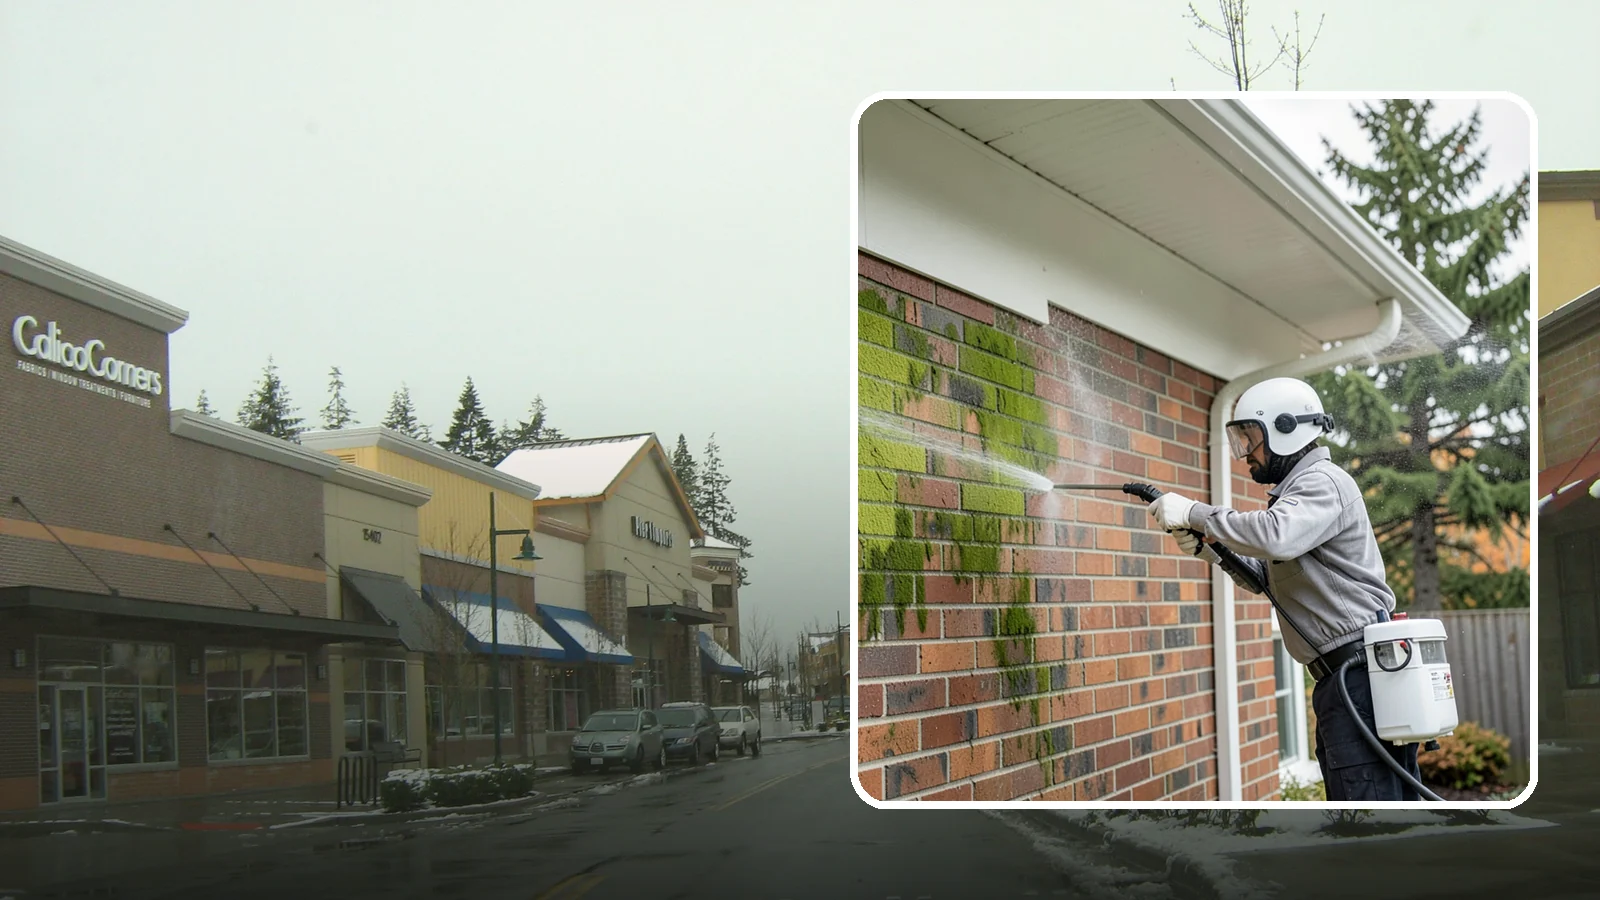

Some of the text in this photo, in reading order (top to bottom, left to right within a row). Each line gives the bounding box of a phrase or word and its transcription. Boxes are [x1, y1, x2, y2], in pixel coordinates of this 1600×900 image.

[17, 360, 151, 408] FABRICS WINDOW TREATMENTS FURNITURE
